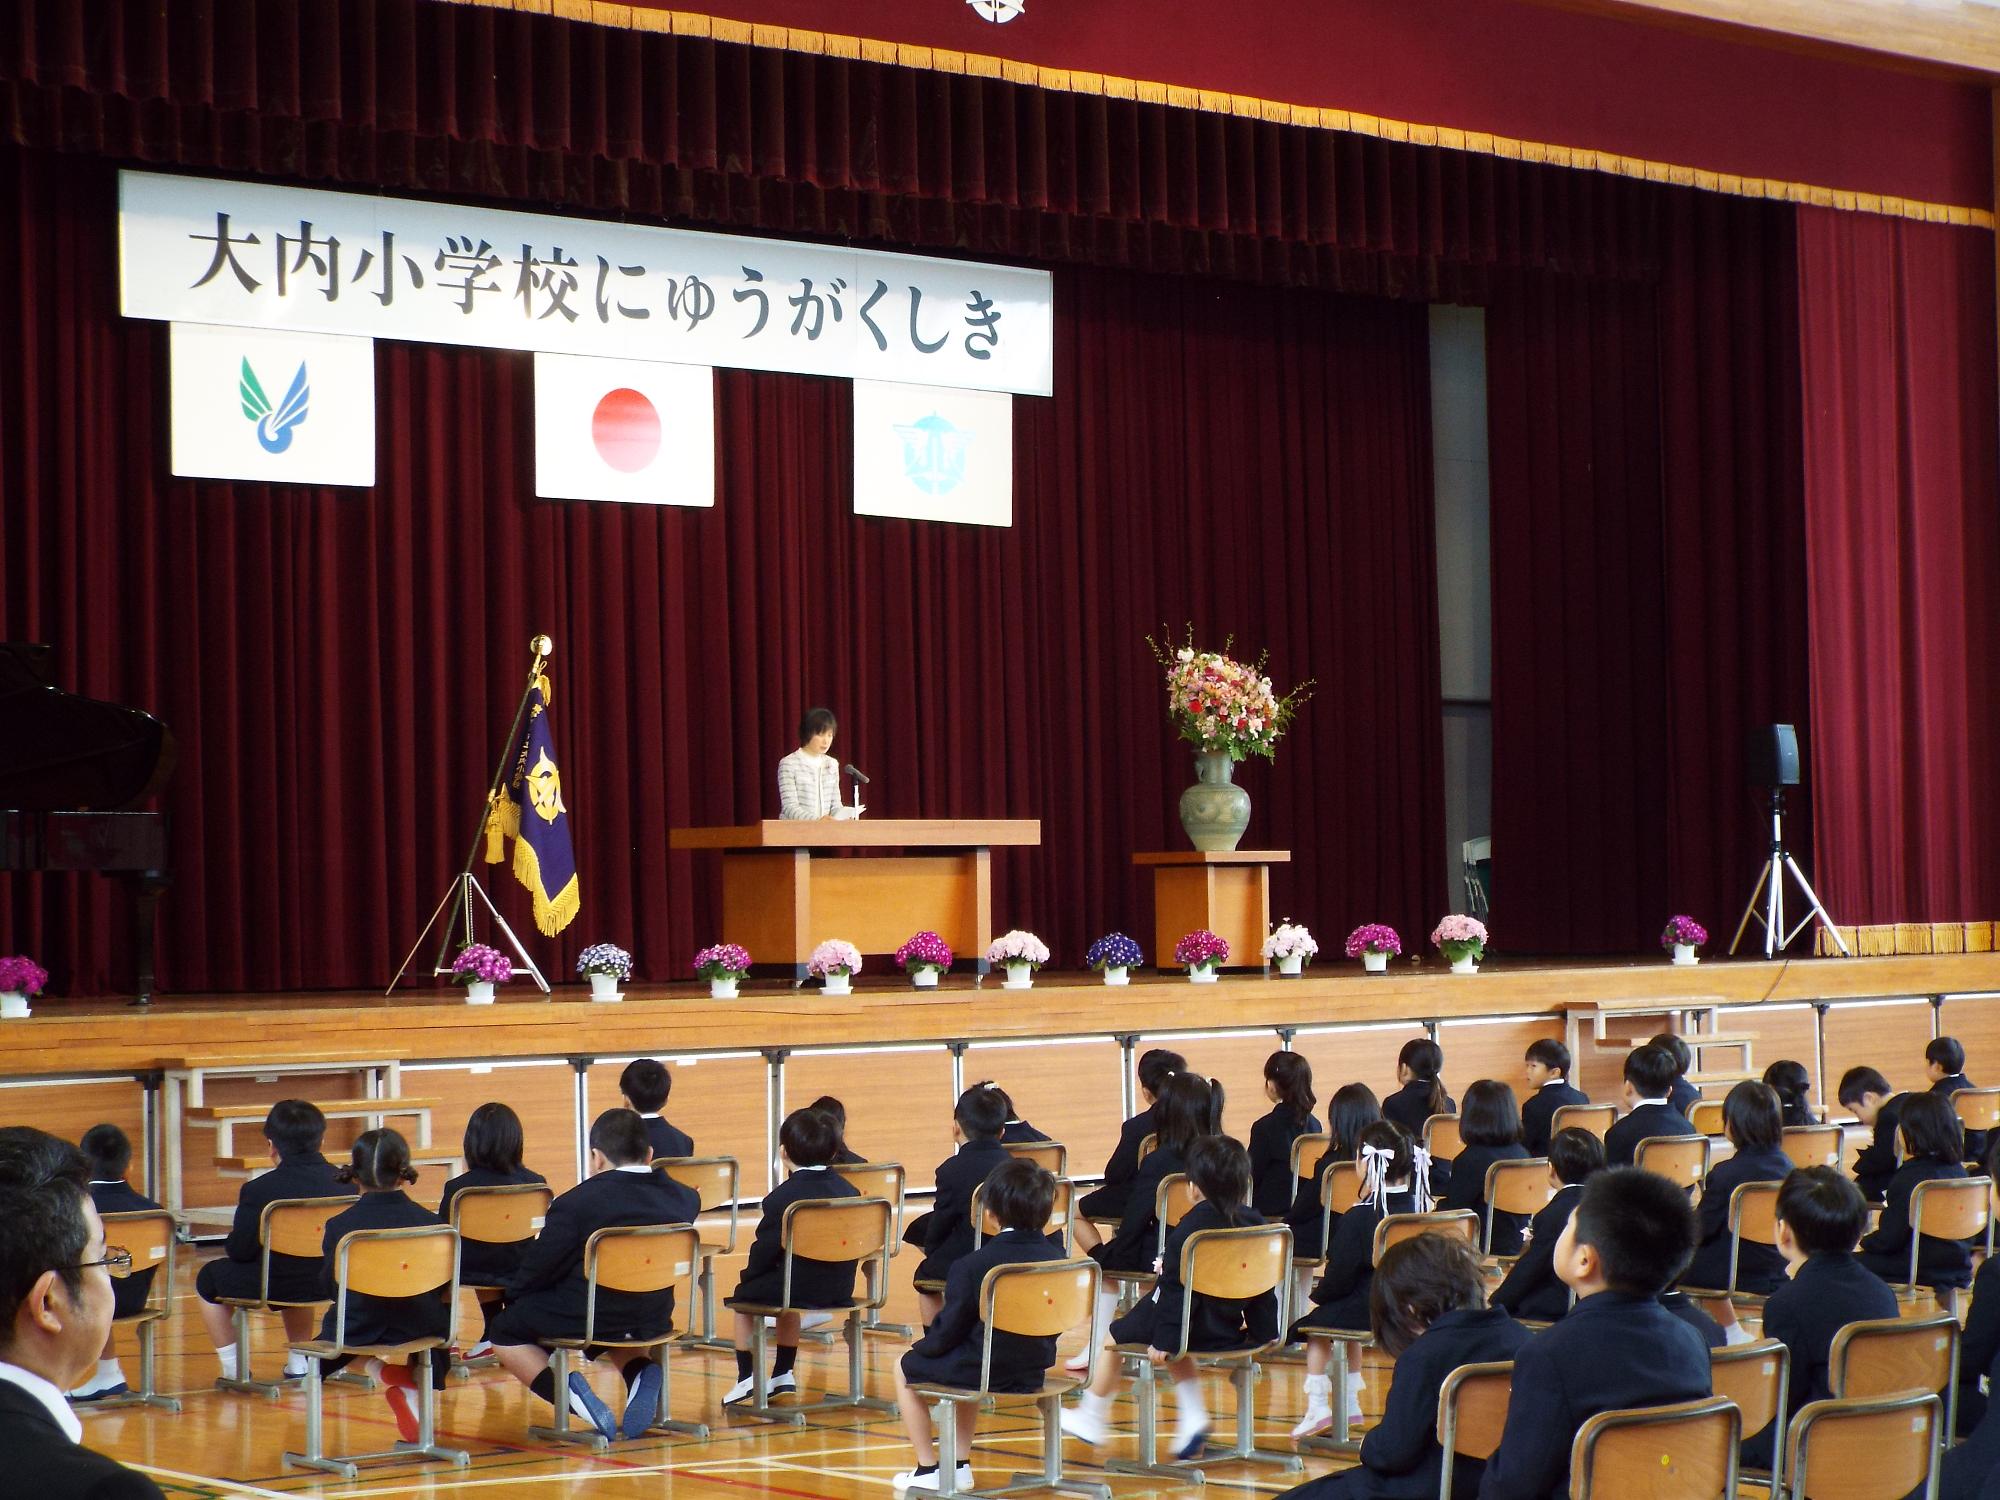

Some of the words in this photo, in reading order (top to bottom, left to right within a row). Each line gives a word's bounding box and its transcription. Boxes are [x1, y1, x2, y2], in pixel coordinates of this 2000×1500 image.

[188, 211, 1002, 360] 大内小学校にゅうがくしき
